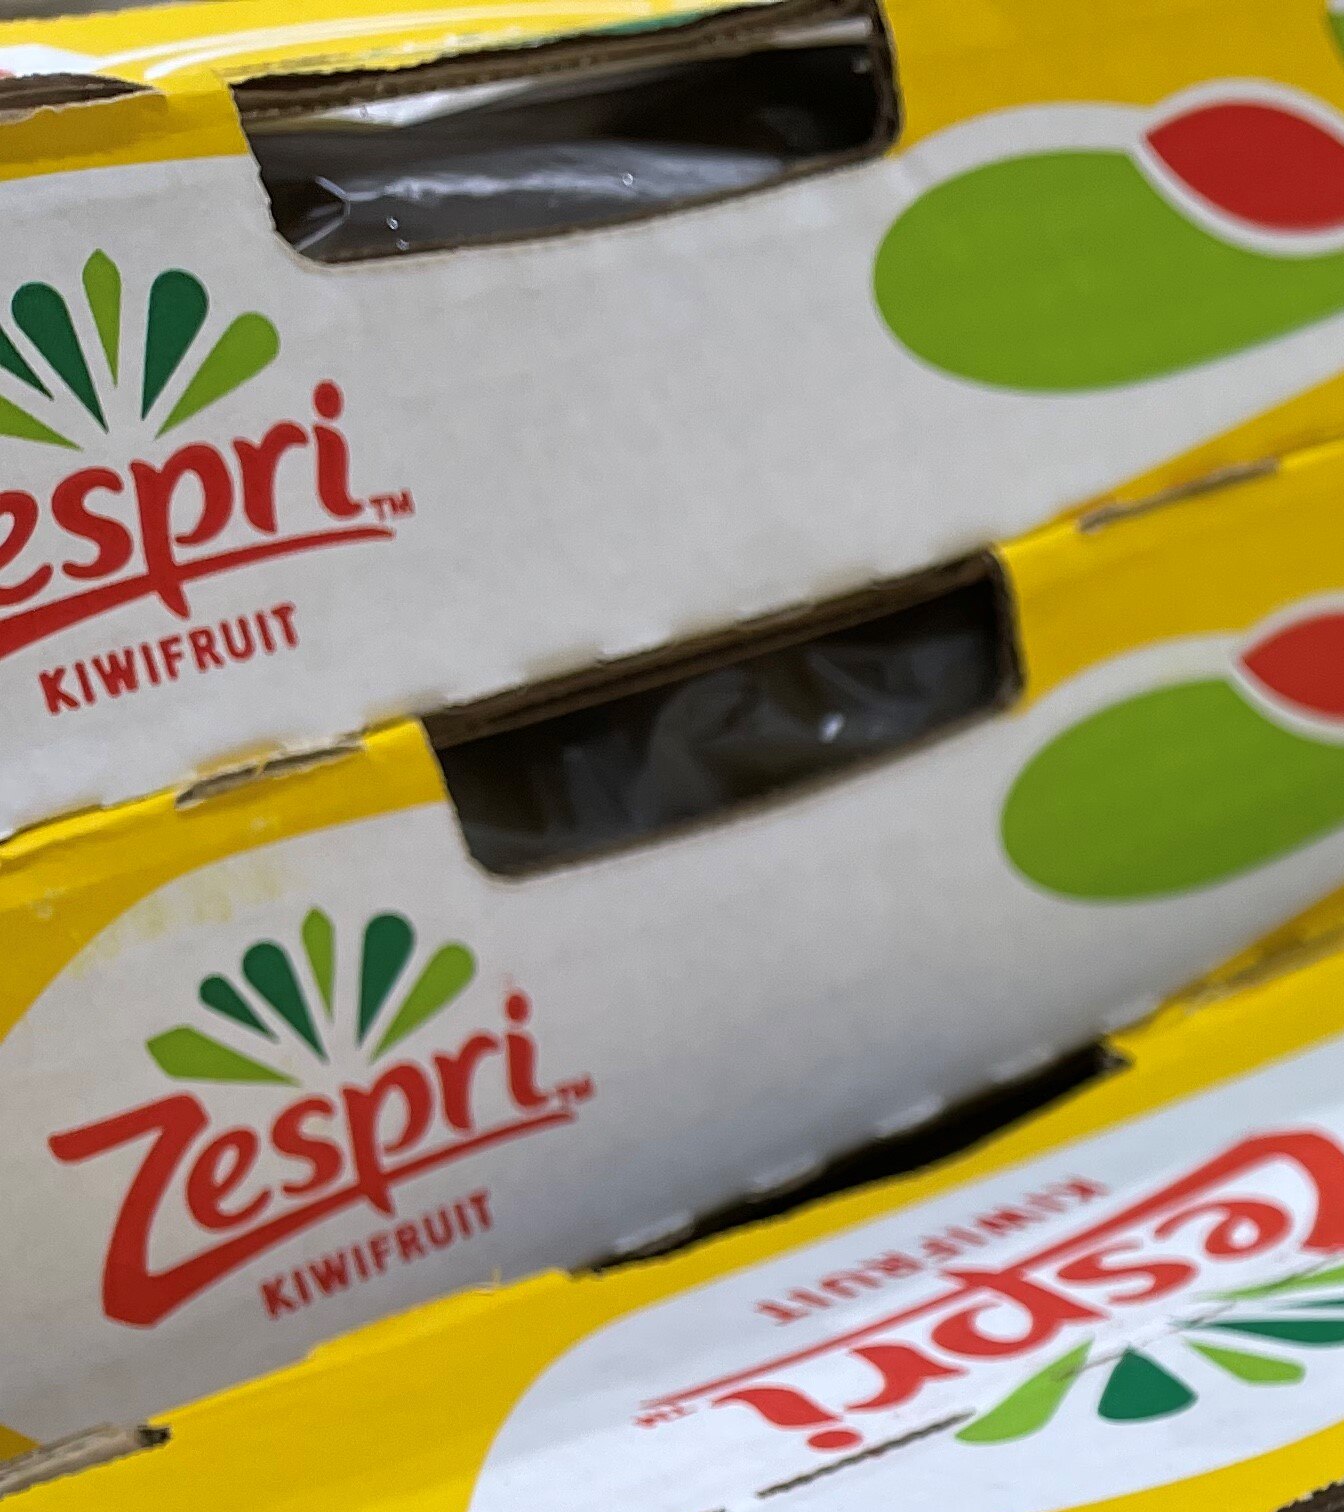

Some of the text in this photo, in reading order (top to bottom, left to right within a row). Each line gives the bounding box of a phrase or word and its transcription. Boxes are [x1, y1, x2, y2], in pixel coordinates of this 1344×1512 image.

[0, 380, 394, 662] espri
[38, 603, 300, 716] KIWIFRUIT
[48, 991, 578, 1329] Zespri
[260, 1190, 497, 1322] KIWIFRUIT
[755, 1176, 1109, 1326] KIWIFRUIT
